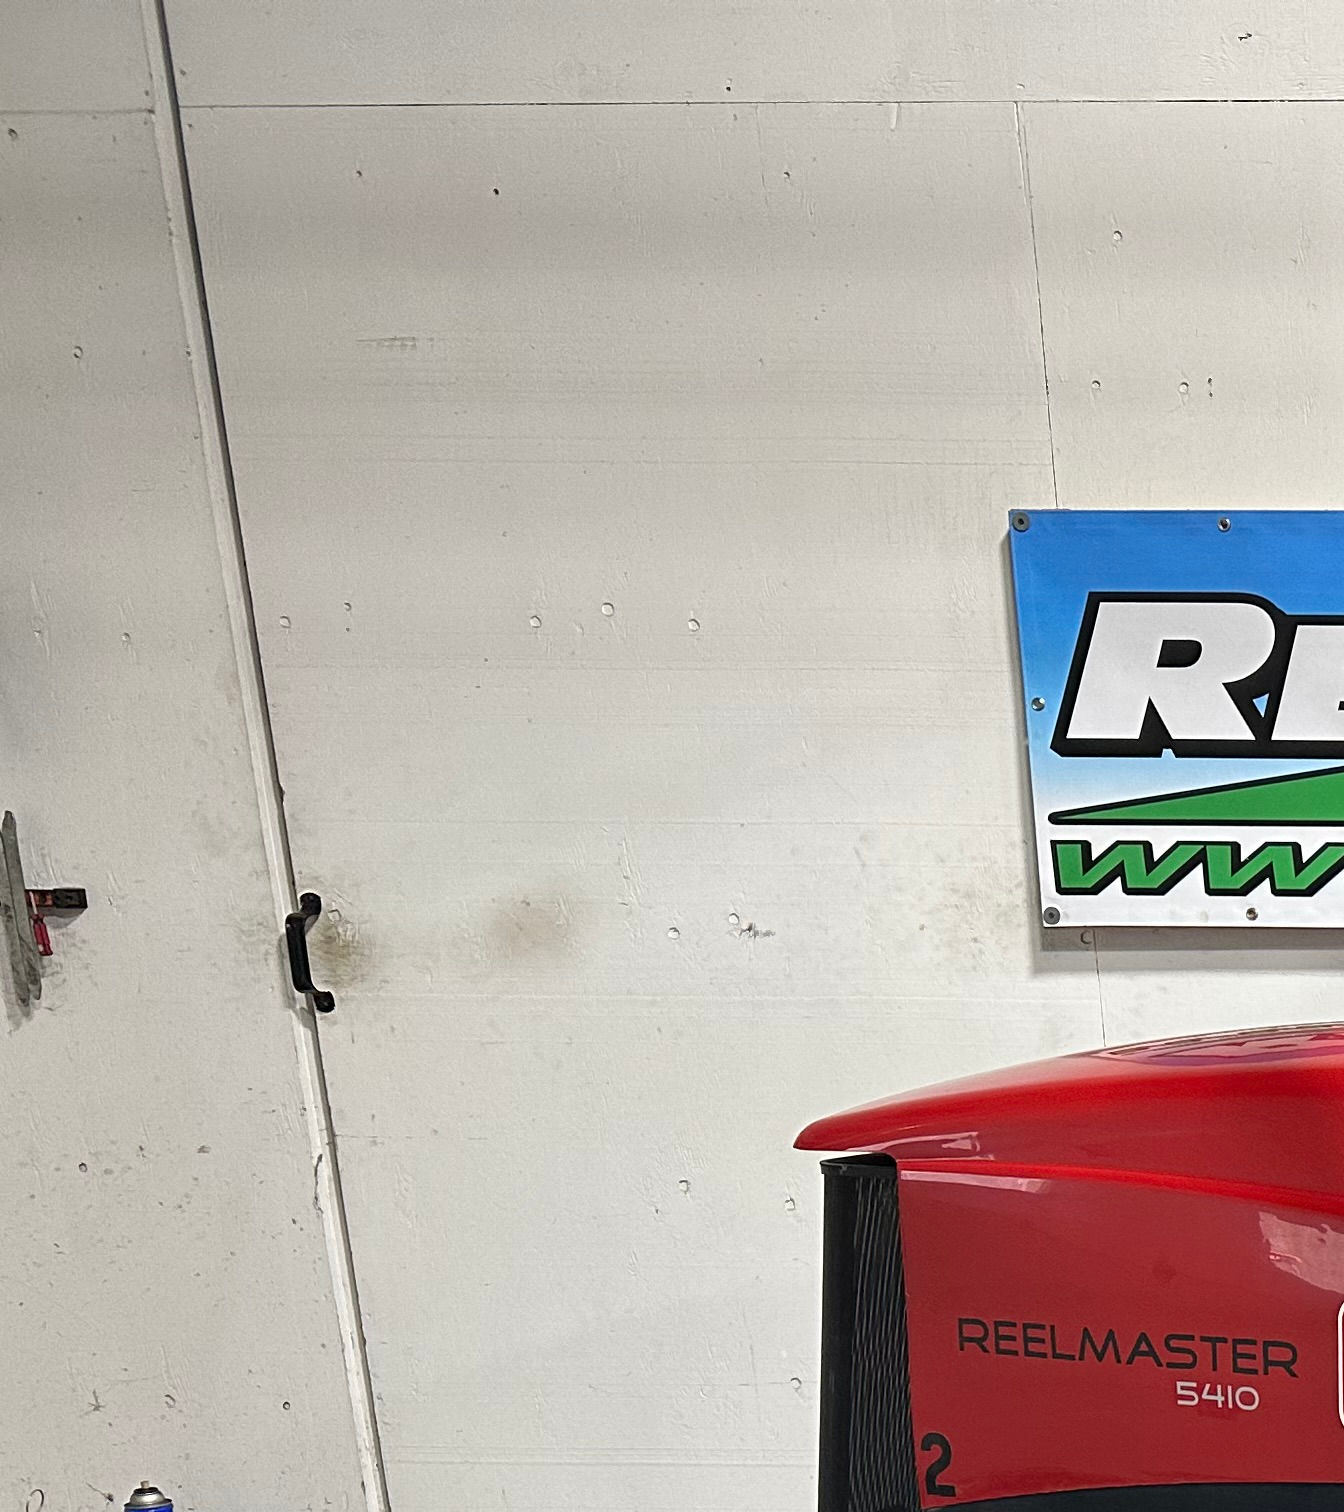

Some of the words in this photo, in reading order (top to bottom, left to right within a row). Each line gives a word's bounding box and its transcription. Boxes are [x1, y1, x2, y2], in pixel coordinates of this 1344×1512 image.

[957, 1317, 1300, 1378] REELMASTER
[1175, 1381, 1261, 1411] 5410
[919, 1432, 956, 1497] 2
